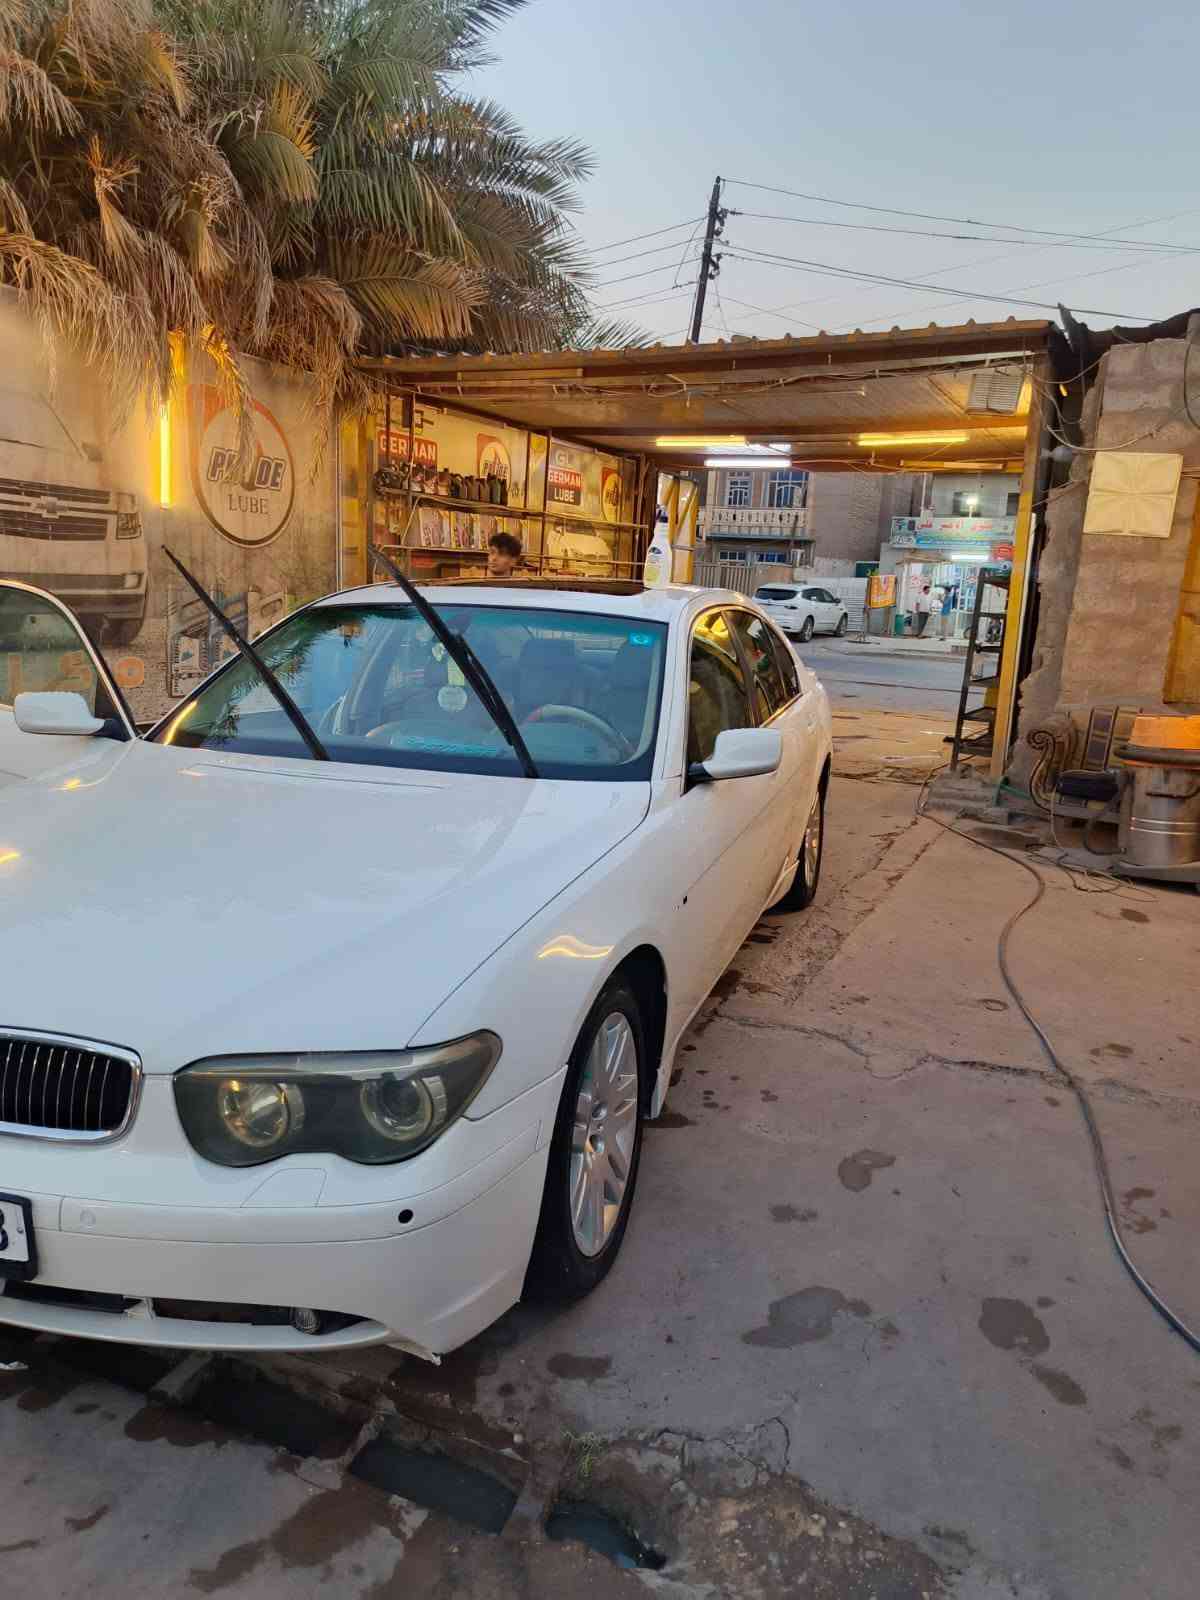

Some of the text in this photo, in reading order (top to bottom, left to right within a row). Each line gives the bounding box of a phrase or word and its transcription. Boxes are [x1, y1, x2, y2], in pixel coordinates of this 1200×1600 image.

[548, 469, 581, 488] GERMAN
[554, 487, 576, 502] LUBE
[227, 494, 269, 515] LUBE
